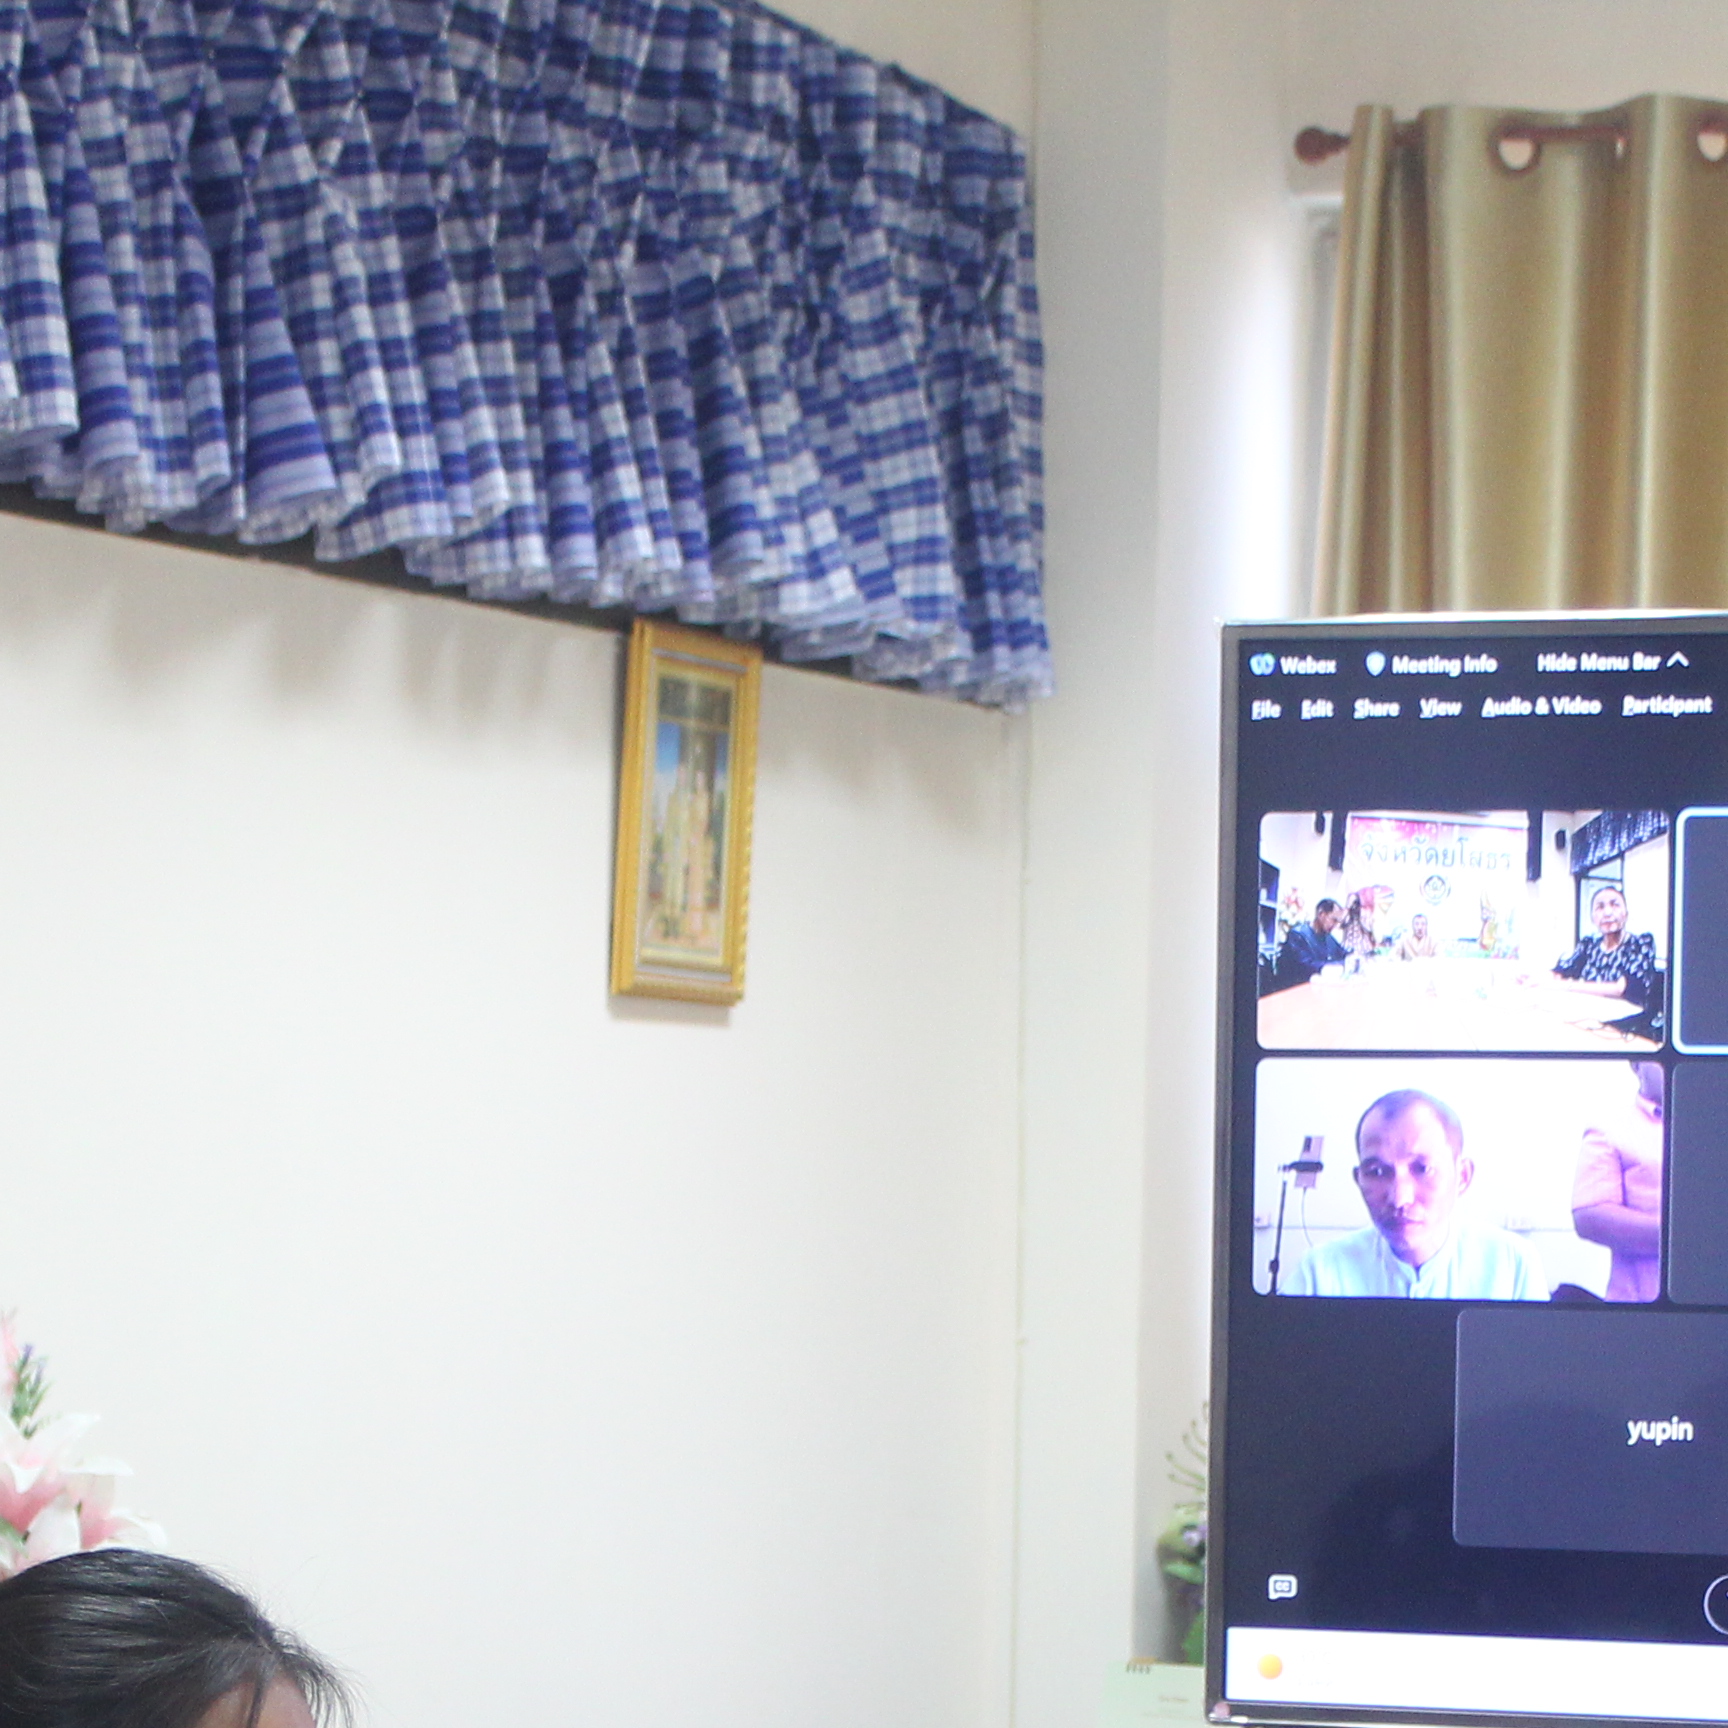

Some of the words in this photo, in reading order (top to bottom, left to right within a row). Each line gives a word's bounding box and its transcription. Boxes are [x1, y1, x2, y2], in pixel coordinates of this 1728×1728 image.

[1280, 655, 1337, 675] Webex
[1392, 654, 1461, 677] Meeting
[1465, 653, 1499, 674] Info
[1538, 653, 1576, 672] Hide
[1581, 653, 1629, 672] Menu
[1633, 652, 1661, 671] Bar
[1252, 699, 1281, 720] File
[1301, 699, 1334, 719] Edit
[1353, 698, 1400, 719] Share
[1419, 698, 1462, 719] View
[1482, 697, 1532, 717] Audio
[1535, 697, 1549, 715] &
[1552, 695, 1602, 715] Video
[1622, 694, 1713, 718] Participant
[1627, 1416, 1694, 1446] yupin
